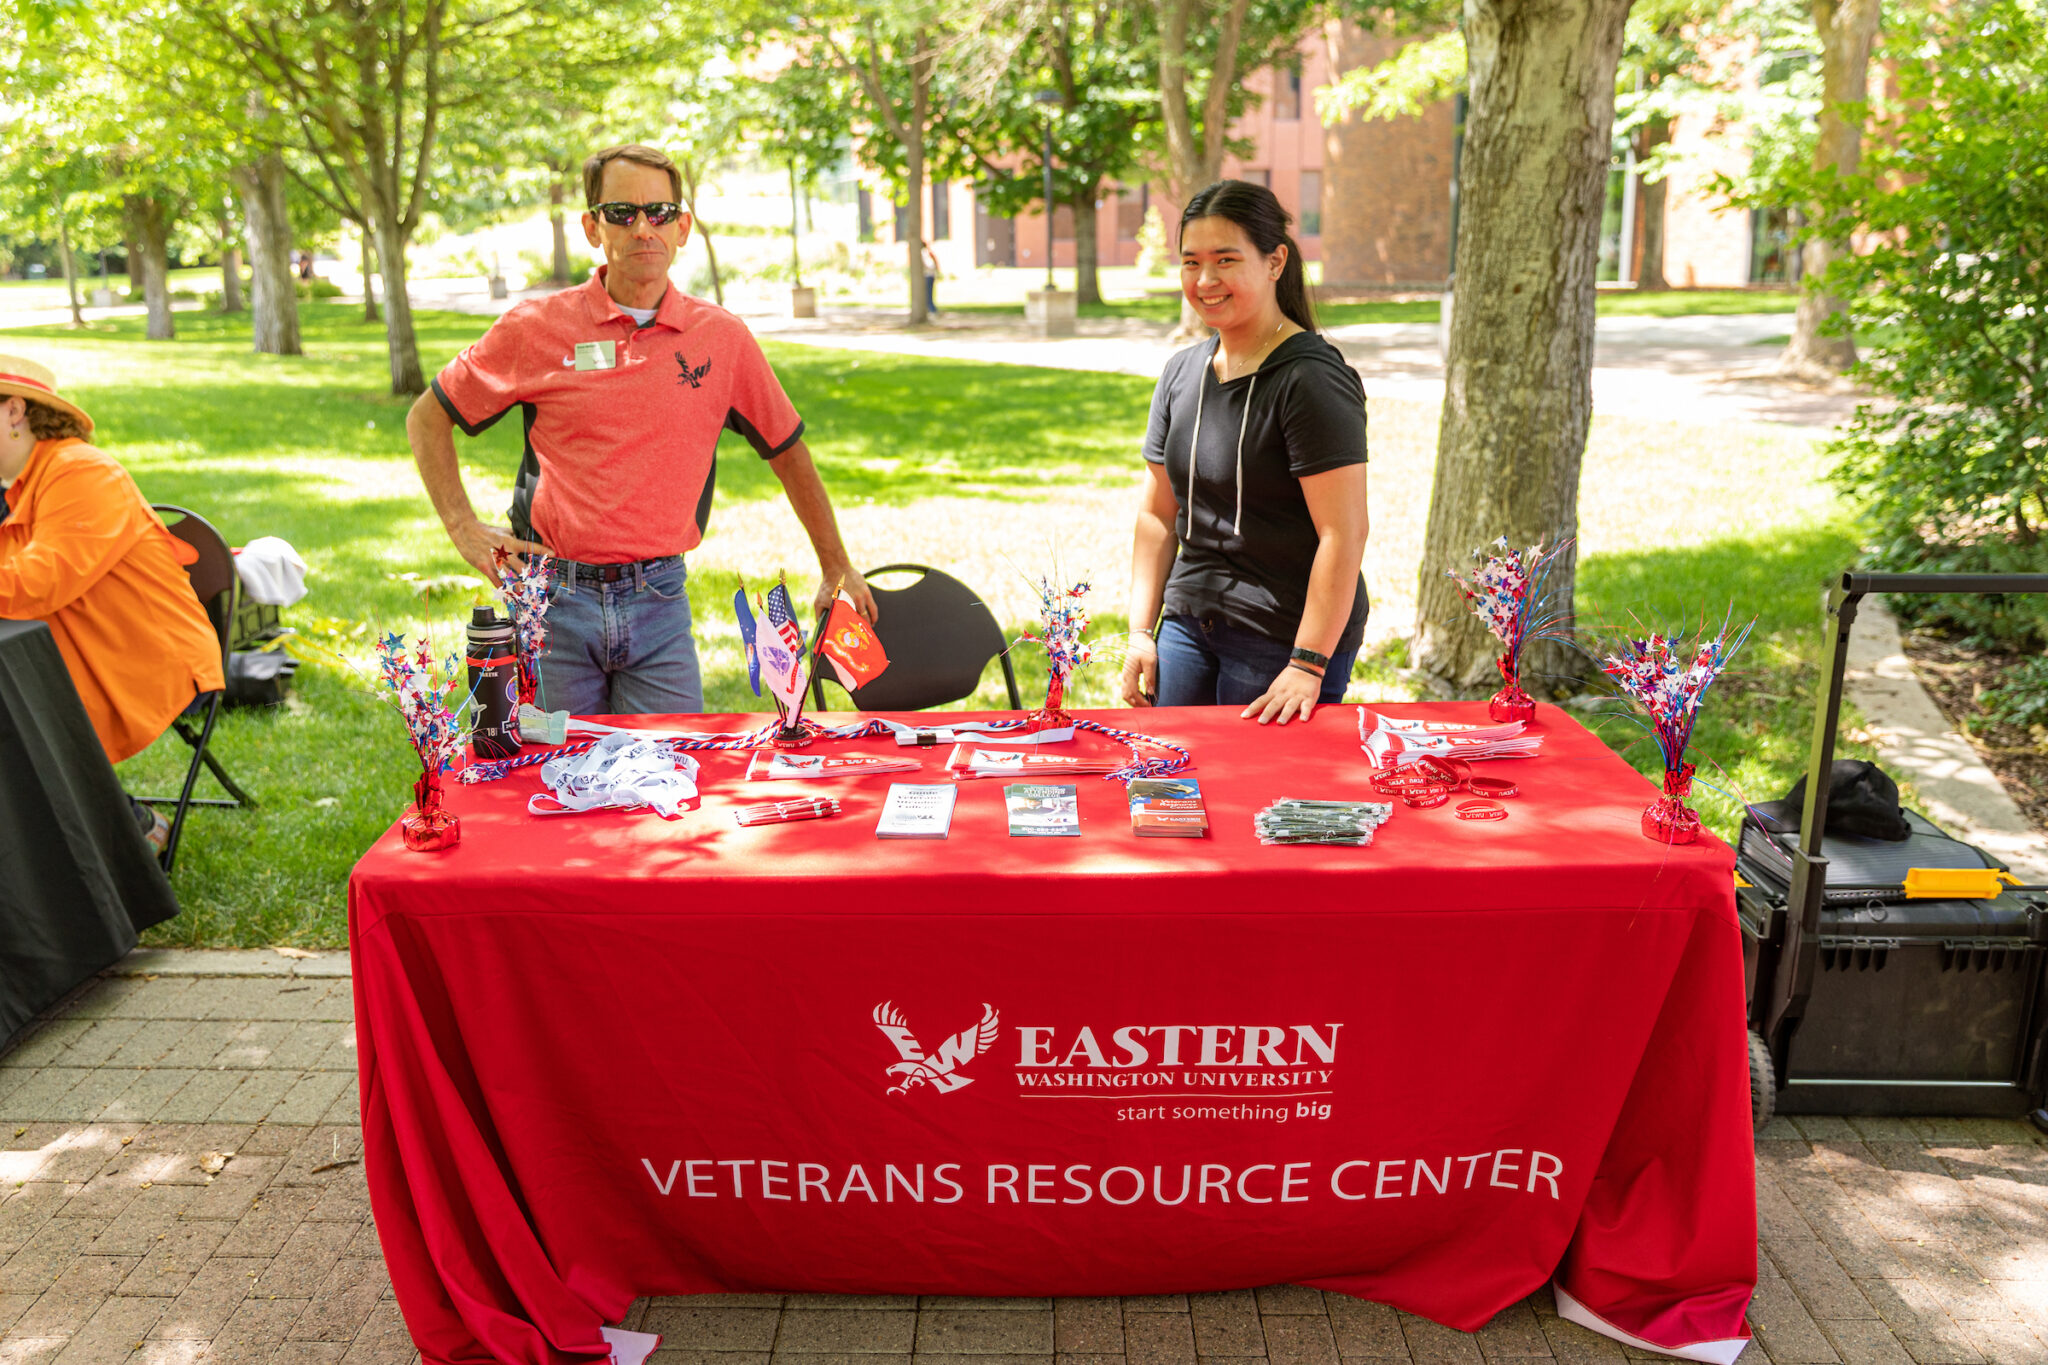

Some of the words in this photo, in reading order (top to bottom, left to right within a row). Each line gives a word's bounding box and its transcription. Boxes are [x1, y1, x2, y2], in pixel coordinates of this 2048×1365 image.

[1427, 722, 1477, 731] EWU
[826, 757, 878, 767] EWU
[1026, 755, 1079, 763] EWU
[1015, 1023, 1344, 1068] EASTERN
[1016, 1071, 1174, 1088] WASHINGTON
[1184, 1070, 1333, 1087] UNIVERSITY
[1117, 1105, 1165, 1122] start
[1172, 1103, 1289, 1123] something
[1296, 1101, 1332, 1120] big
[641, 1158, 964, 1204] VETERANS
[987, 1161, 1311, 1206] RESOURCE
[1330, 1148, 1564, 1200] CENTER
